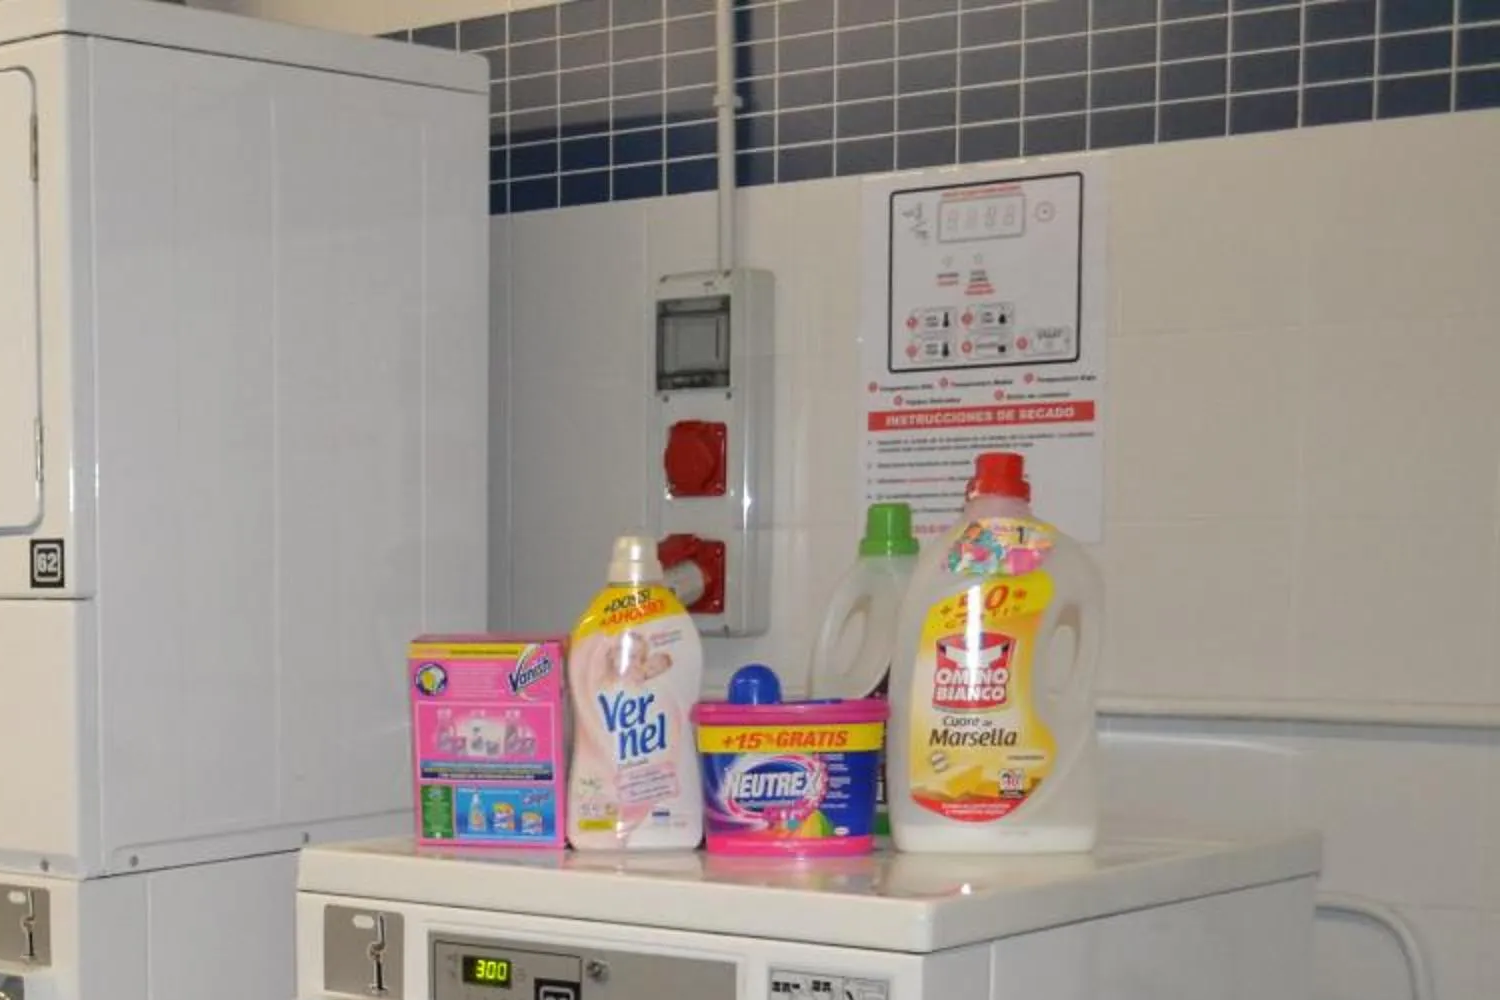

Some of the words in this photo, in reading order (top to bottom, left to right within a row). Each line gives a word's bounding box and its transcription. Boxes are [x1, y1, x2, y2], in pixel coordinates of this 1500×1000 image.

[886, 411, 994, 427] INSTRUCCIONES
[996, 410, 1016, 421] DE
[1018, 406, 1076, 420] SECADO
[509, 656, 552, 693] Vanish
[936, 667, 1010, 685] OMNO
[935, 686, 1007, 702] BIANCO
[597, 690, 655, 733] Ver
[619, 712, 667, 760] nel
[776, 729, 849, 748] GRATIS
[928, 728, 1018, 747] Marsella
[726, 769, 821, 800] NEUTREX
[475, 959, 508, 981] 300
